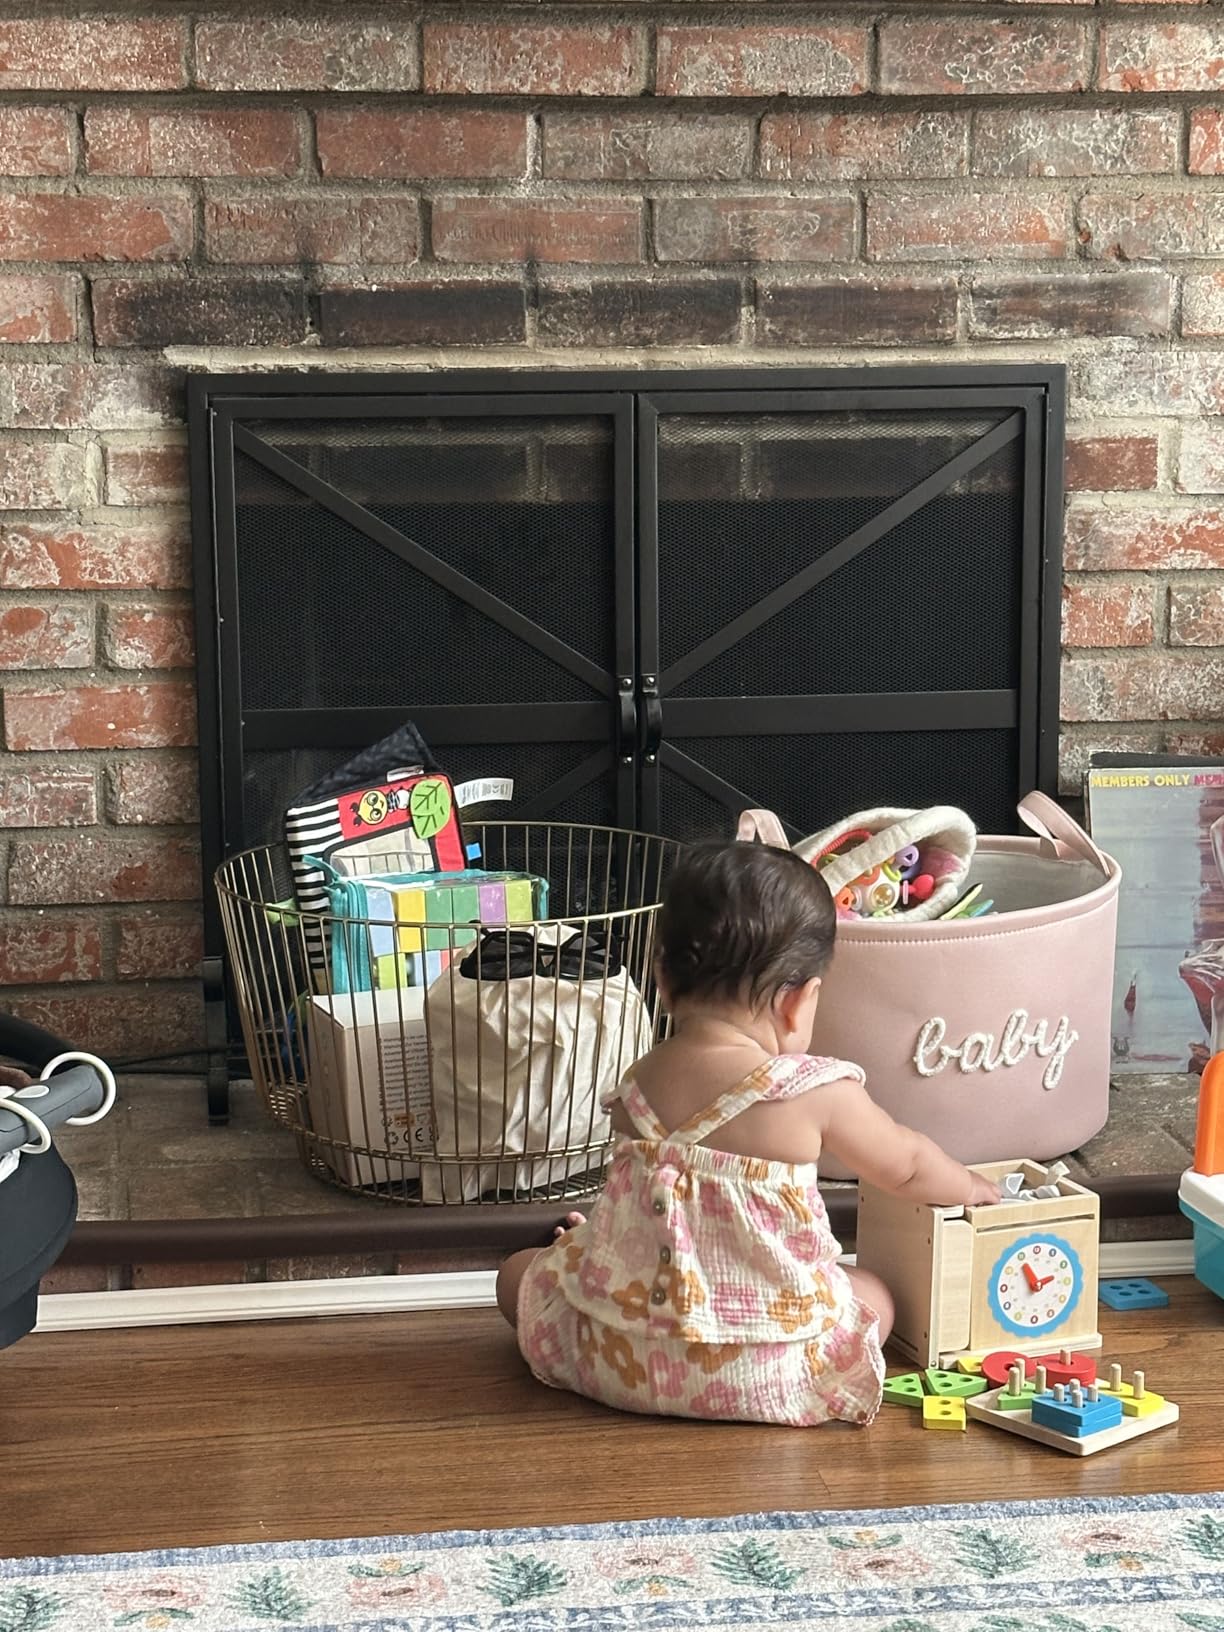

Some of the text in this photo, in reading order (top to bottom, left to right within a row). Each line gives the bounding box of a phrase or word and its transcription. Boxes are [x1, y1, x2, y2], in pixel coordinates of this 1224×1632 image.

[1091, 775, 1150, 788] MEMBERS
[1154, 774, 1190, 787] ONLY
[913, 1008, 1079, 1090] baby
